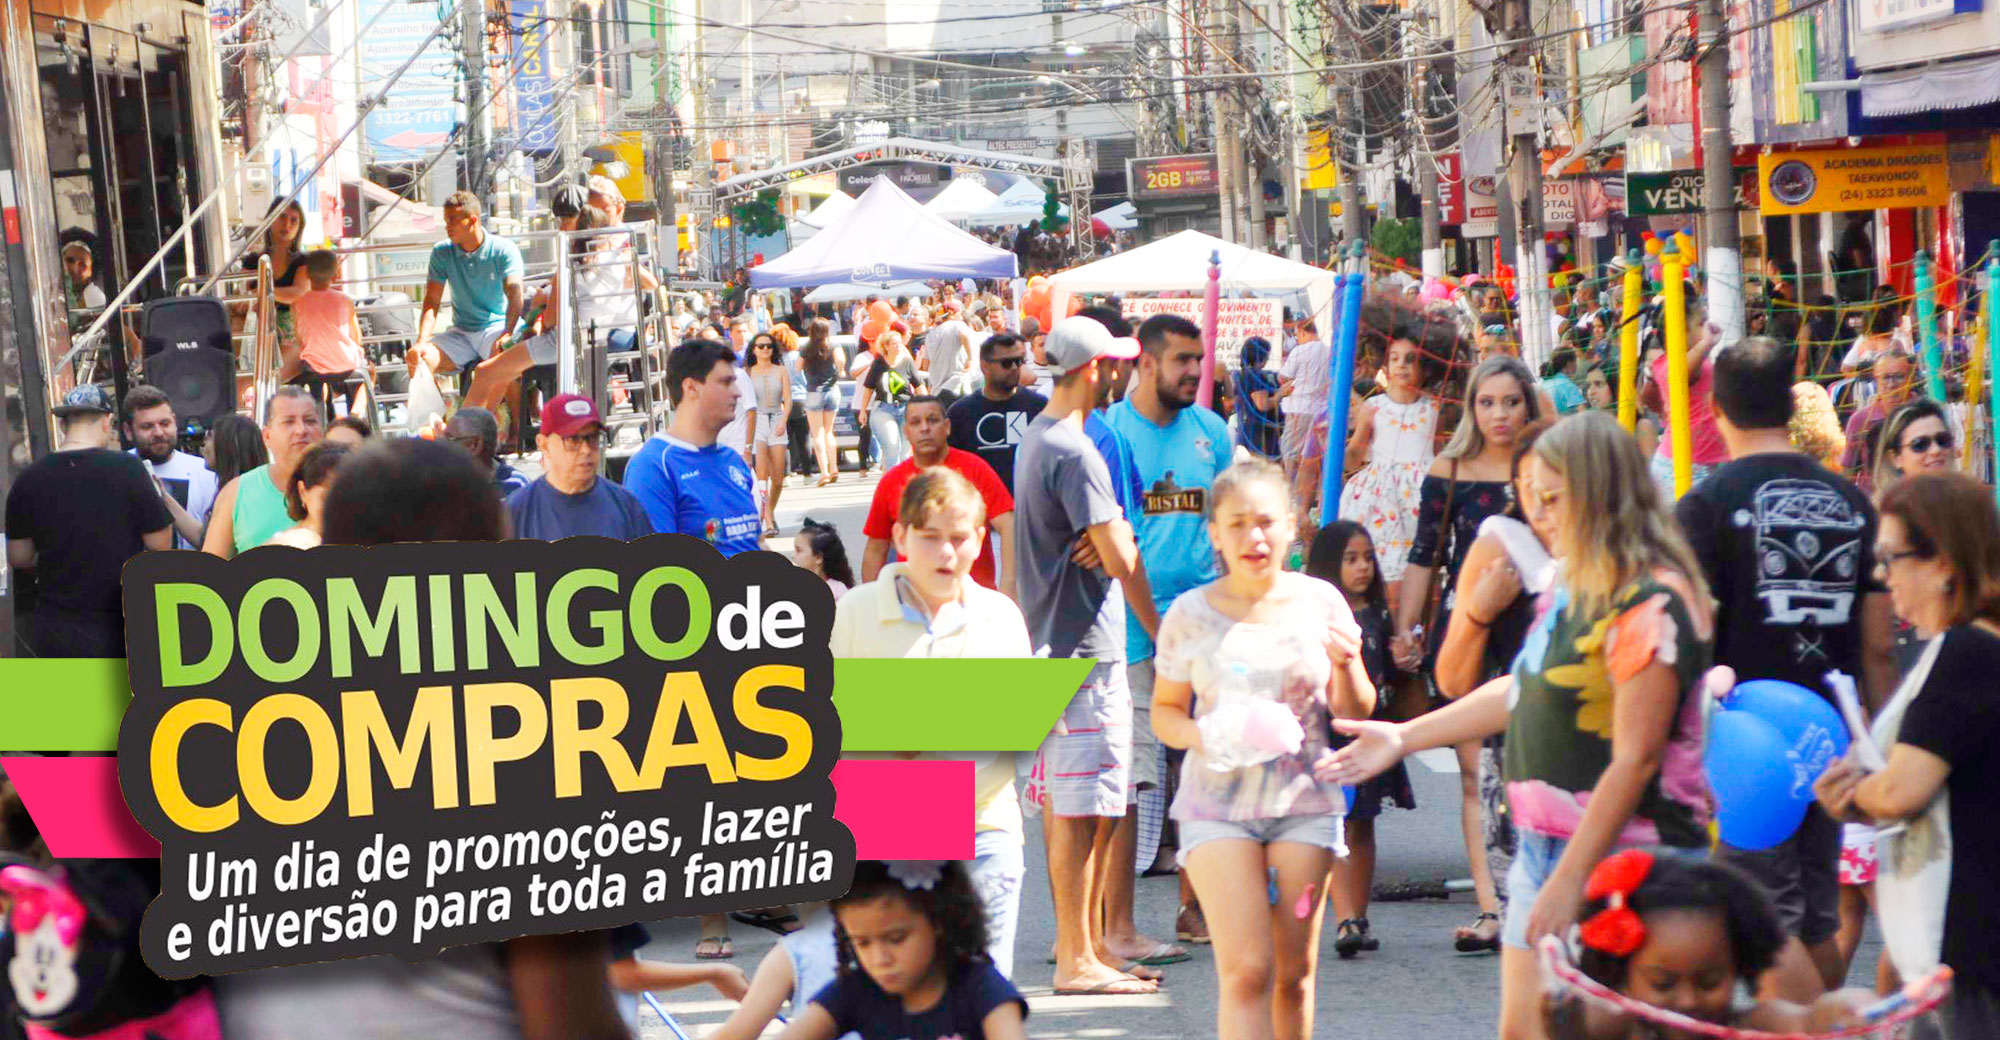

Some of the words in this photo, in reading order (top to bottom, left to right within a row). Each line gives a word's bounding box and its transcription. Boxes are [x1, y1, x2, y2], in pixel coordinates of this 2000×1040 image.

[1824, 157, 1883, 169] ACADEMIA
[1147, 171, 1182, 189] 2GB
[1849, 171, 1919, 184] TAEKWONDO
[1142, 302, 1192, 313] CONHECE
[1218, 302, 1272, 313] OVIMENTO
[176, 341, 198, 350] WLS
